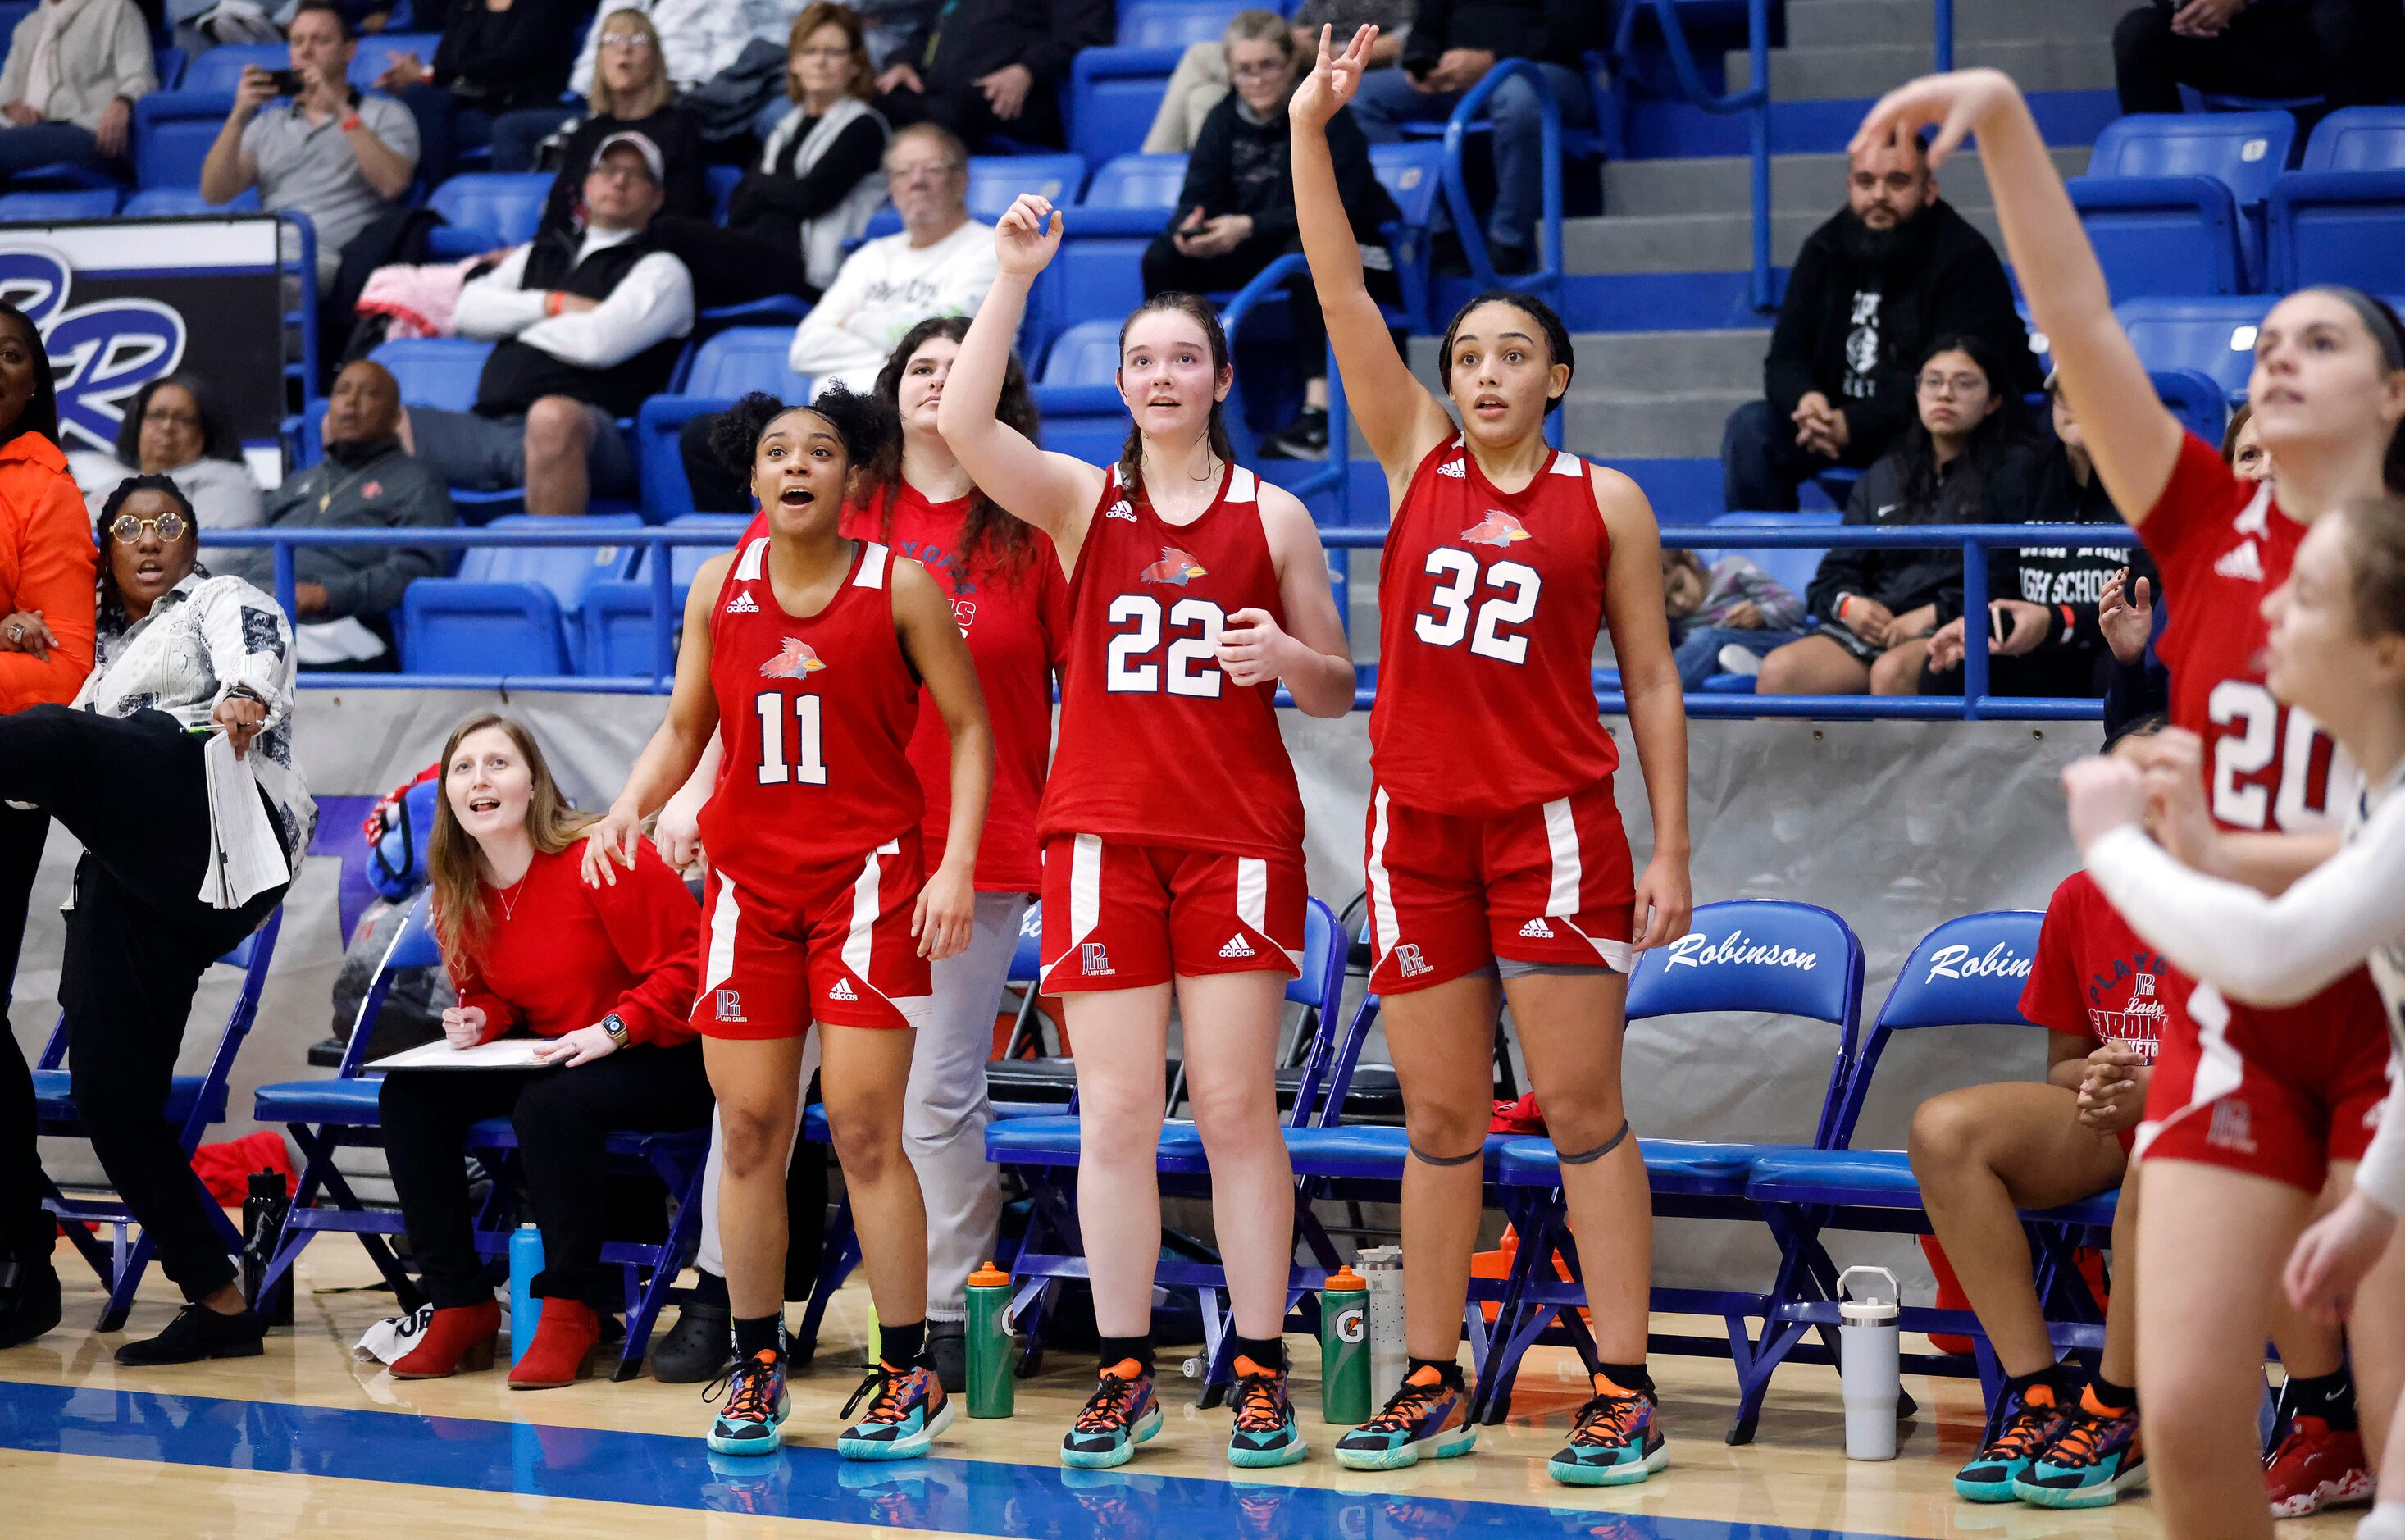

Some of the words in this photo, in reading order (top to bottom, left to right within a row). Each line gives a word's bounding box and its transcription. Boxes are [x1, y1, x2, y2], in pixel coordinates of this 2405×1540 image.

[1105, 509, 1138, 522] adidas
[727, 604, 760, 613] adidas
[1414, 545, 1543, 667] 32
[1107, 593, 1225, 699] 22
[756, 690, 828, 786] 11
[2208, 678, 2358, 833] 20
[1519, 927, 1555, 939] adidas
[1218, 947, 1255, 958] adidas
[1664, 929, 1817, 973] Robinson
[1924, 941, 2034, 985] Robin
[1418, 964, 1434, 974] CARDS
[2089, 951, 2168, 1005] PLAYO
[828, 991, 859, 1001] adidas
[2124, 997, 2166, 1018] Lady
[2088, 1008, 2169, 1041] CARDIN
[1335, 1308, 1365, 1345] G
